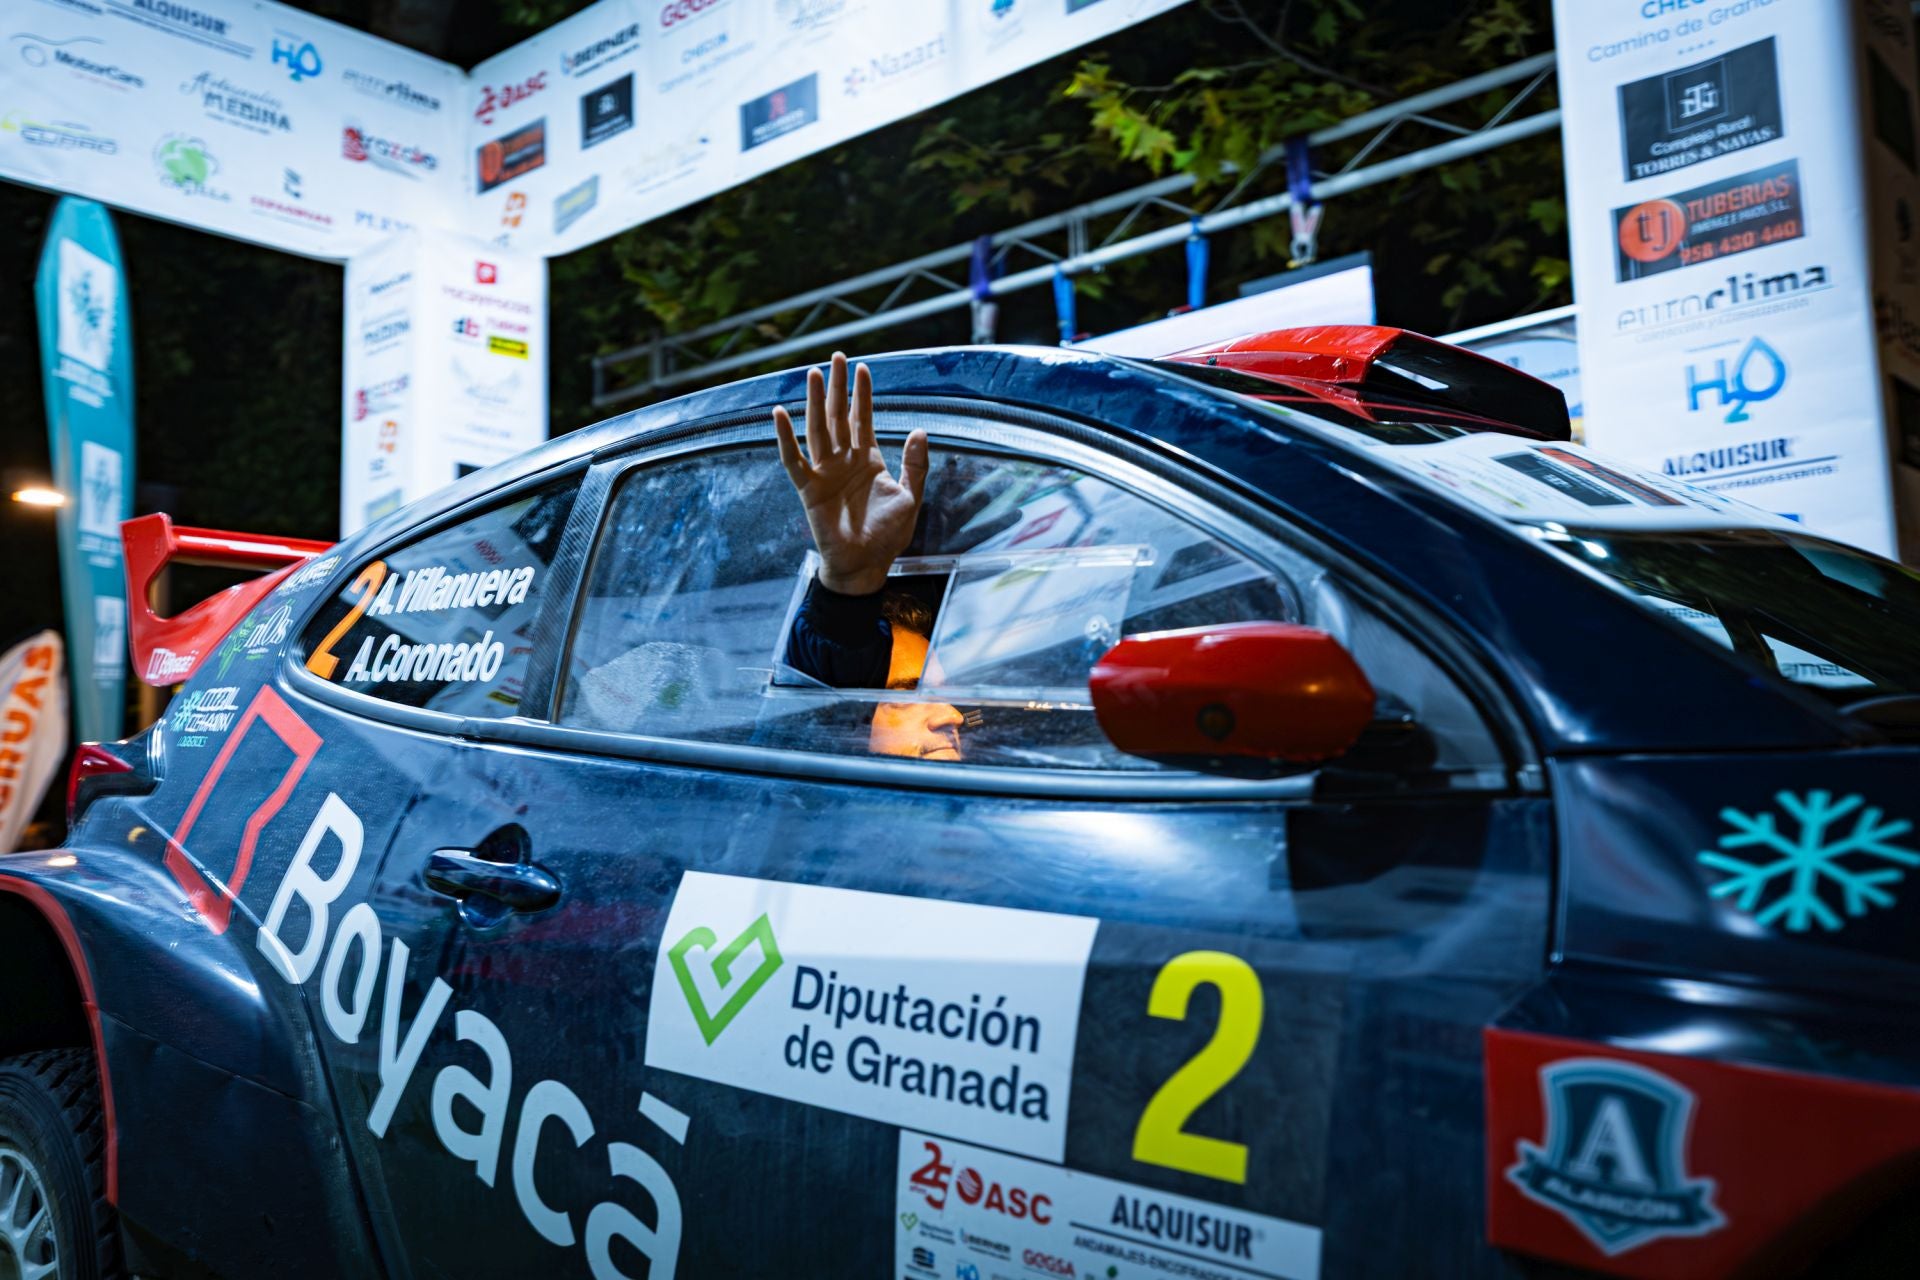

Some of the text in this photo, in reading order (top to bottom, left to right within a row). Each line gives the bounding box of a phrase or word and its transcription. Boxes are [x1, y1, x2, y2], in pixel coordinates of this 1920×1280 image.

[1587, 28, 1671, 62] Camino
[1675, 18, 1704, 37] de
[1686, 173, 1791, 222] TUBERIAS
[1662, 437, 1790, 477] ALQUISUR
[304, 559, 388, 681] 2
[256, 792, 691, 1280] Boyacá
[791, 964, 1041, 1054] Diputación
[784, 1024, 1051, 1122] de Granada
[1132, 950, 1264, 1185] 2
[1566, 1095, 1657, 1195] A
[1111, 1194, 1254, 1260] ALQUISUR
